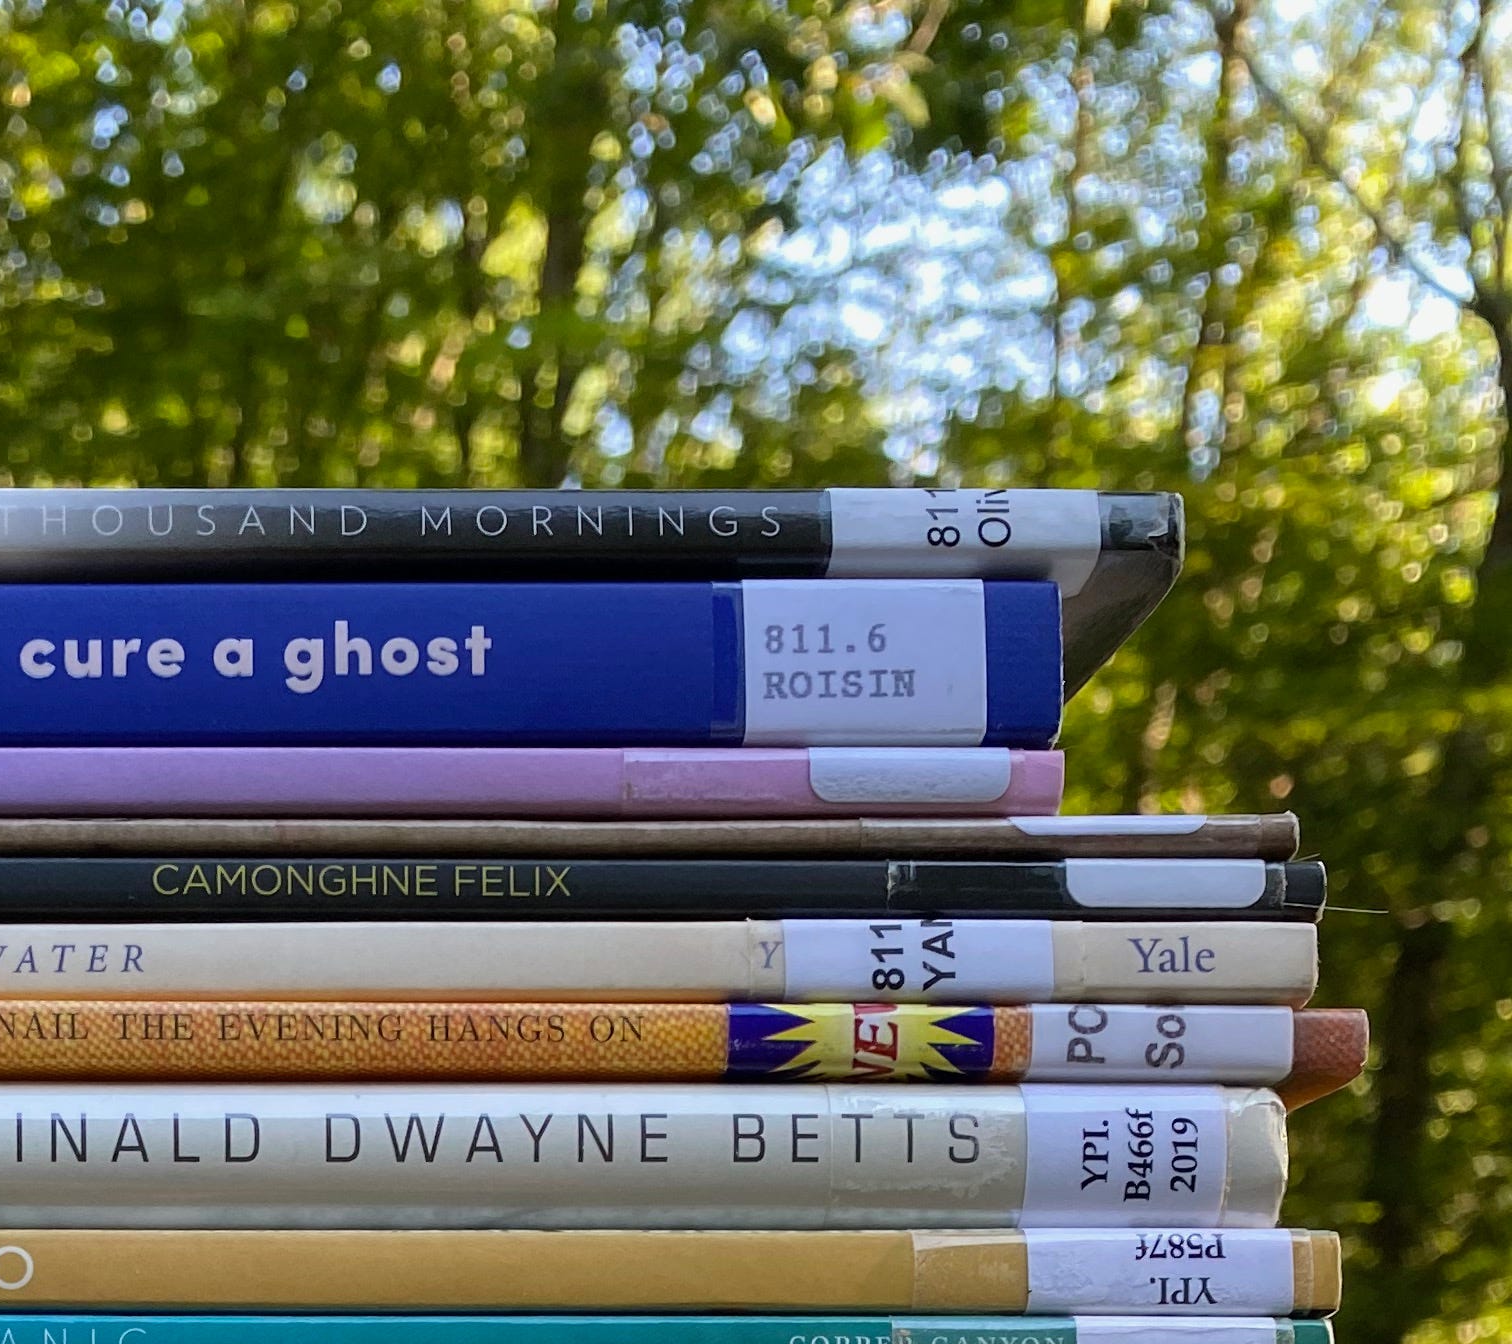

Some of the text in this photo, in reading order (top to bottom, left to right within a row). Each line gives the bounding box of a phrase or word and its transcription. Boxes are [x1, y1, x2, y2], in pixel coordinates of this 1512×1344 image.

[421, 505, 781, 537] MORNINGS
[763, 670, 915, 700] ROISIN
[153, 865, 571, 896] CAMONGHNE FELIX
[1129, 937, 1216, 974] Yale
[327, 1113, 670, 1163] DWAYNE
[734, 1114, 980, 1163] BETTS
[1124, 1108, 1153, 1202] B466f
[1170, 1117, 1198, 1193] 2019
